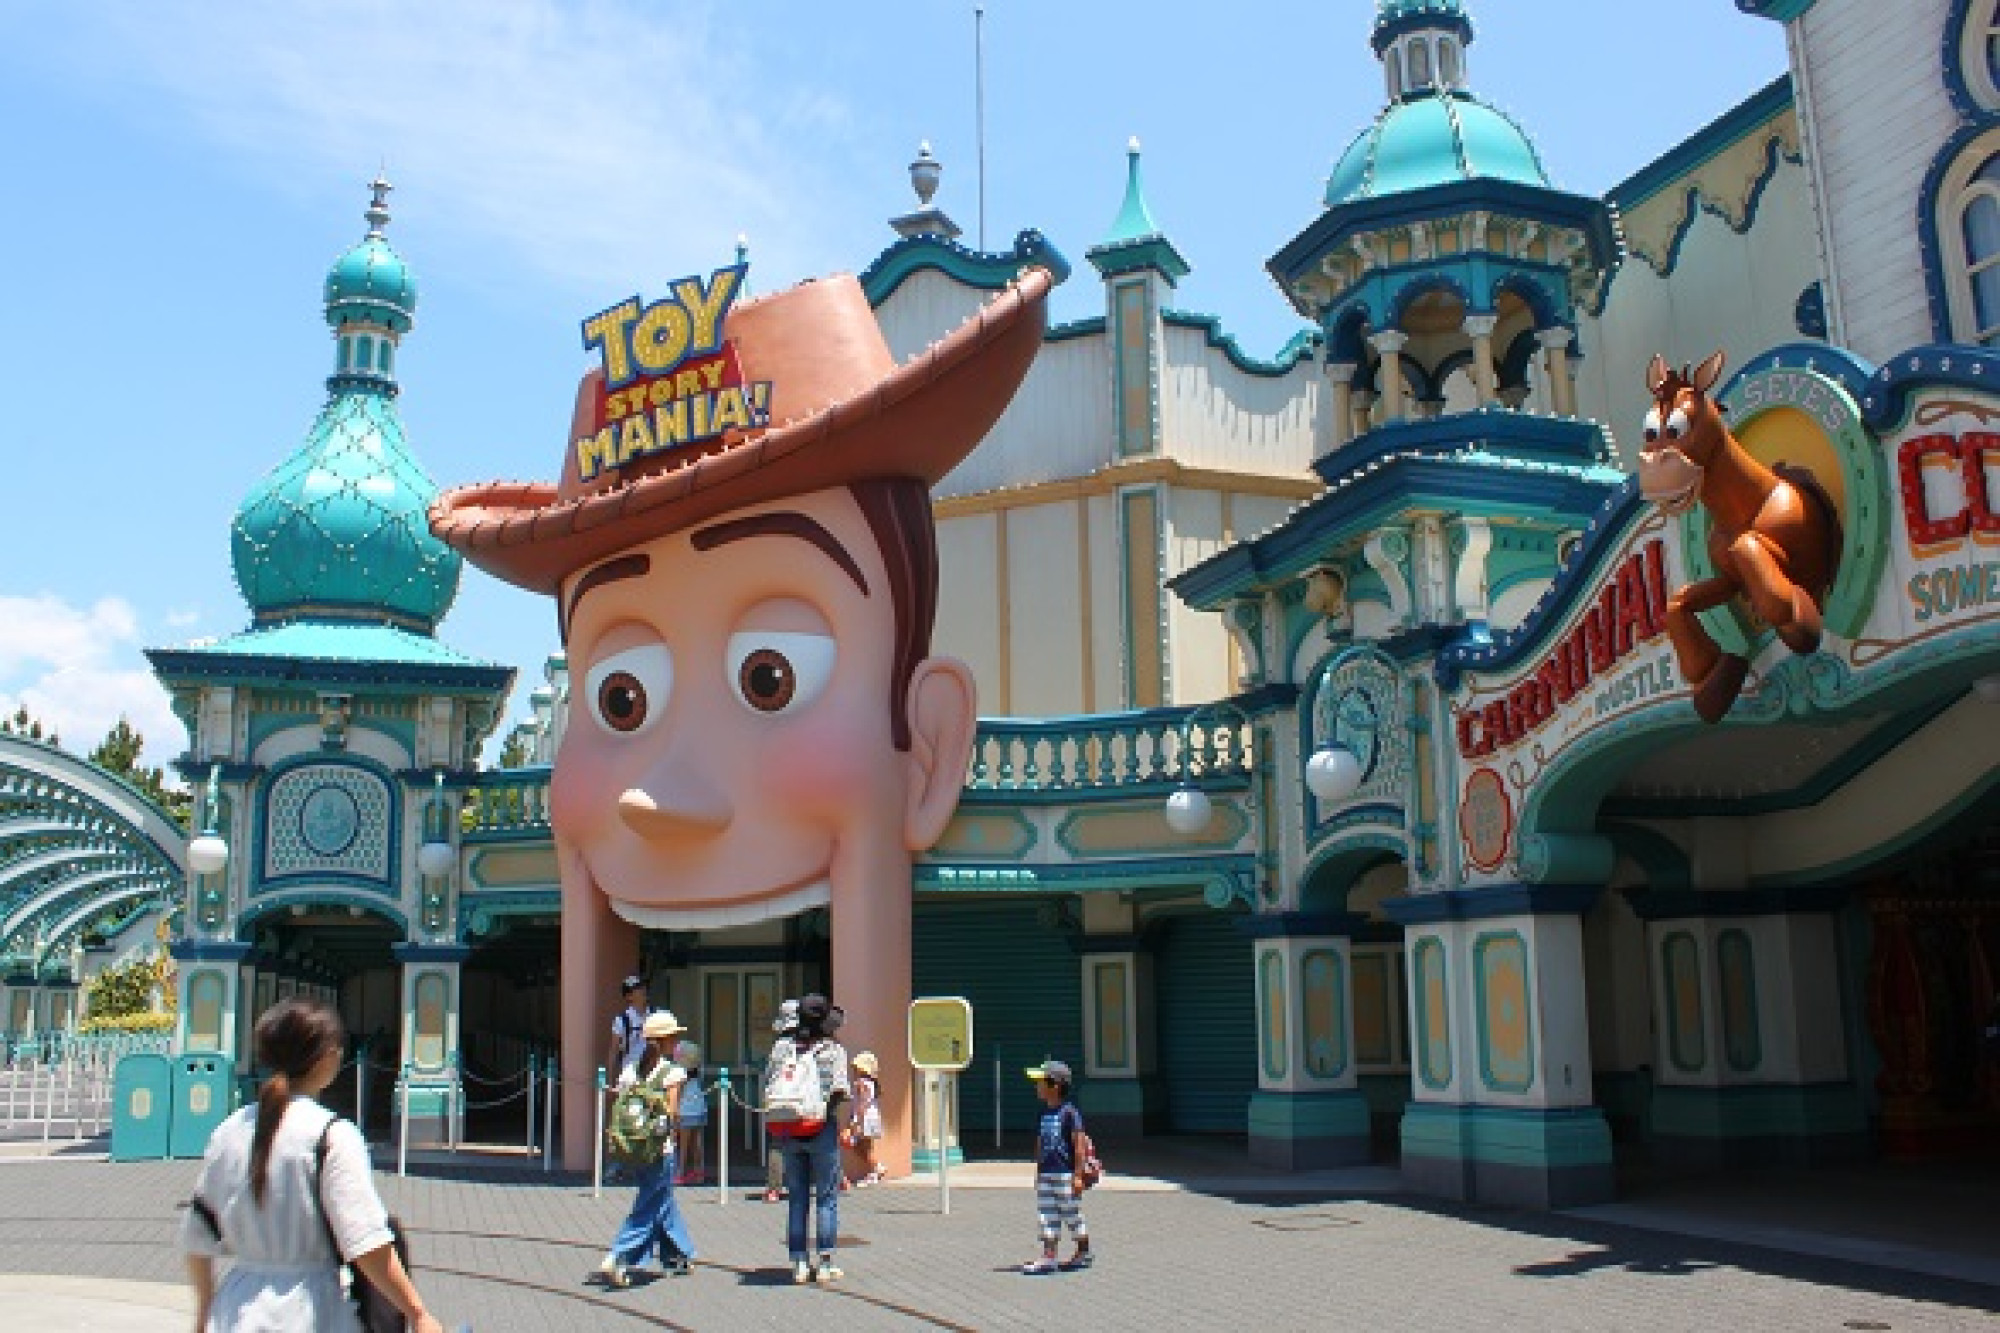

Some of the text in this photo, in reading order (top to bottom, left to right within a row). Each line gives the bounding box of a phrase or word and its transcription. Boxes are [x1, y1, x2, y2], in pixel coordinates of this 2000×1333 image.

[581, 264, 748, 389] TOY
[606, 360, 726, 418] STORY
[1456, 540, 1667, 758] CARNIVAL
